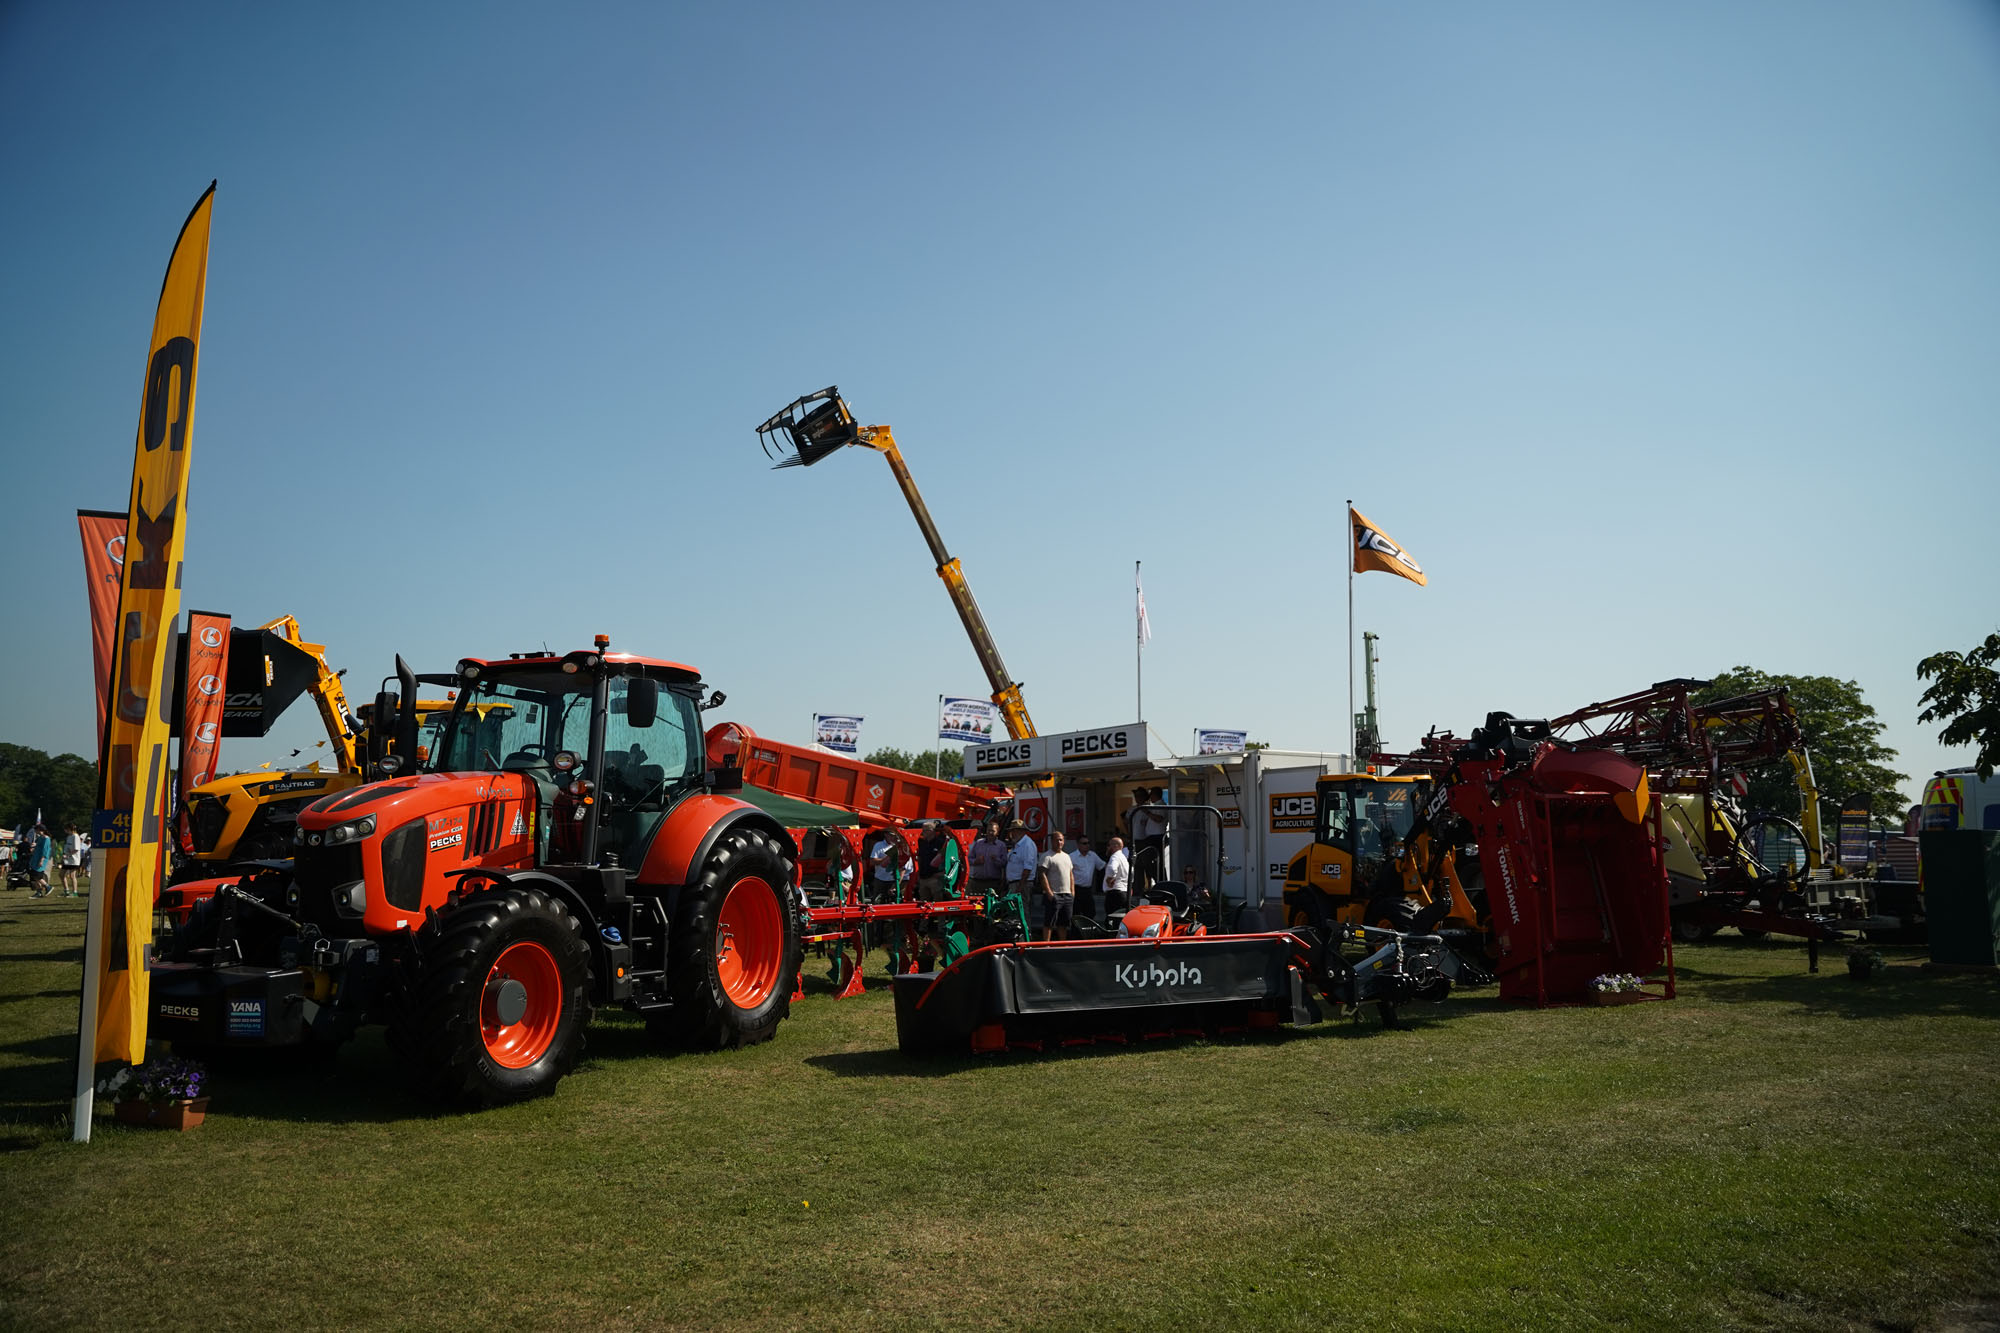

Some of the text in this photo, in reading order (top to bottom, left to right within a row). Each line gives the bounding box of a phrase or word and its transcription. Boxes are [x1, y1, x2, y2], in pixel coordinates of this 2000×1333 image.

[1062, 731, 1128, 754] PECKS
[976, 744, 1031, 764] PECKS
[476, 785, 513, 800] Kubota
[1273, 797, 1316, 816] JCB
[1425, 786, 1449, 822] JCB
[112, 812, 132, 828] 4t
[1275, 819, 1315, 828] AGRICULTURE
[430, 833, 462, 848] PECKS
[1321, 864, 1342, 874] JCB
[1497, 847, 1520, 925] TOMAHAWK
[1115, 961, 1202, 988] Kubota
[160, 1004, 199, 1016] PECKS
[231, 1002, 262, 1012] YANA
